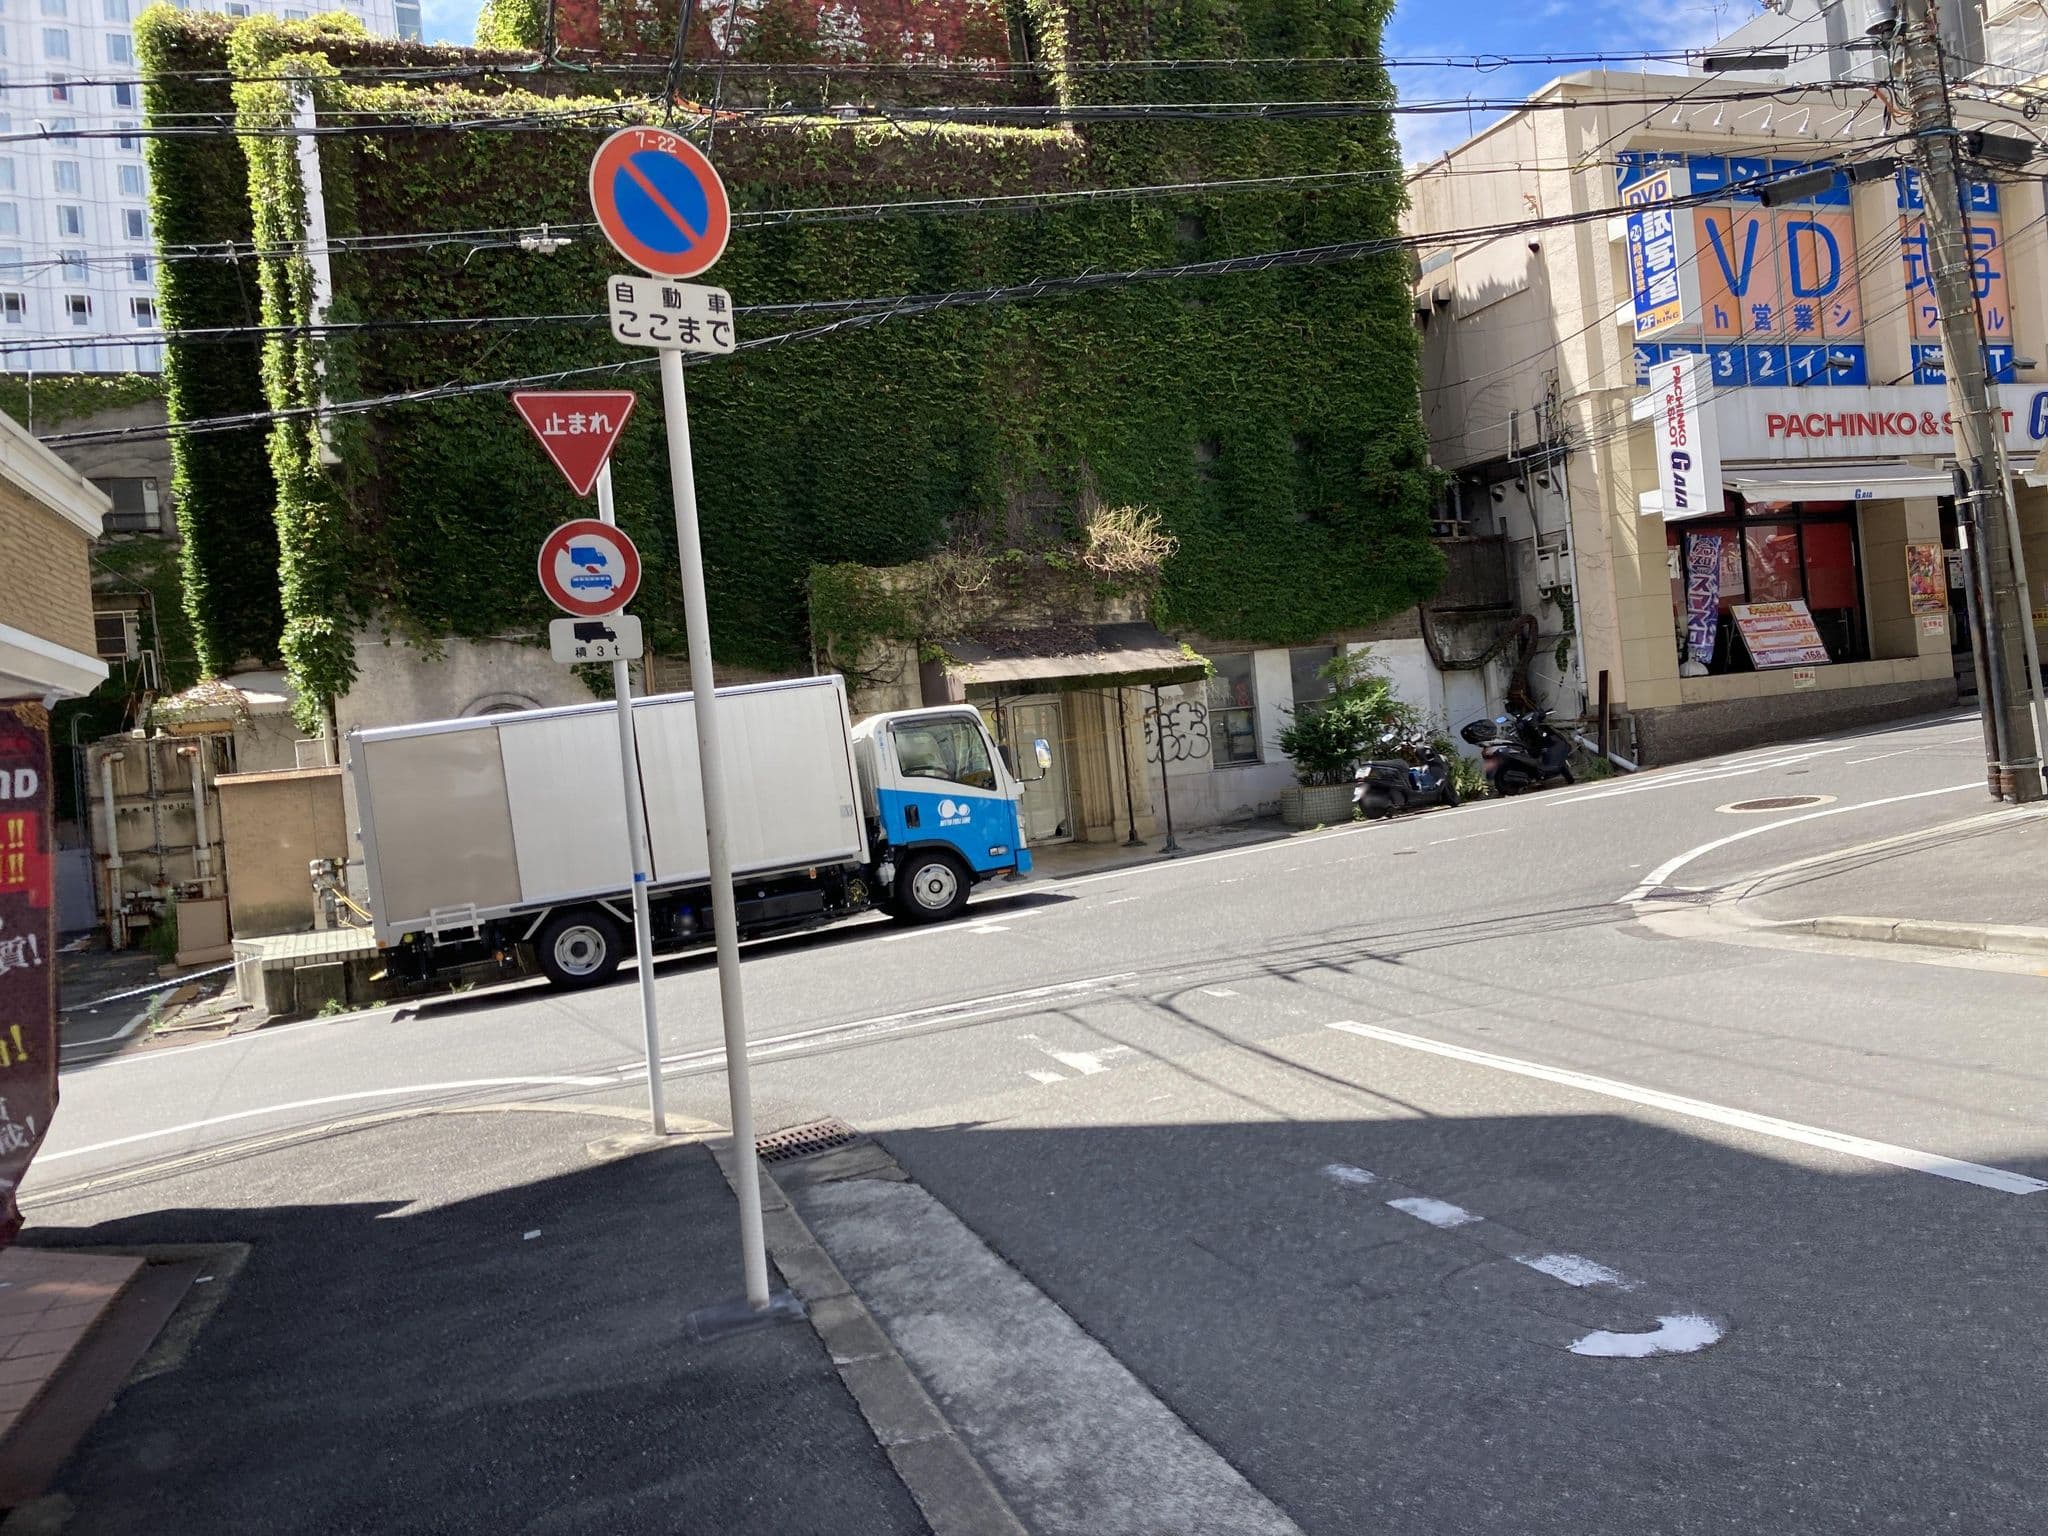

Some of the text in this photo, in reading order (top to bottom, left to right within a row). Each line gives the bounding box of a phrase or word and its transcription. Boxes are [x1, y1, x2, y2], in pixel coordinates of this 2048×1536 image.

[635, 131, 677, 154] 7-22
[1629, 179, 1667, 206] DVD
[615, 282, 727, 314] 自動車
[618, 310, 730, 347] ここまで
[1640, 312, 1680, 331] 2F KING
[1672, 365, 1687, 447] PACHINKO
[542, 411, 613, 435] 止まれ
[1667, 409, 1678, 448] SLOT
[1766, 411, 1918, 438] PACHINKO
[1671, 449, 1691, 509] GAIA
